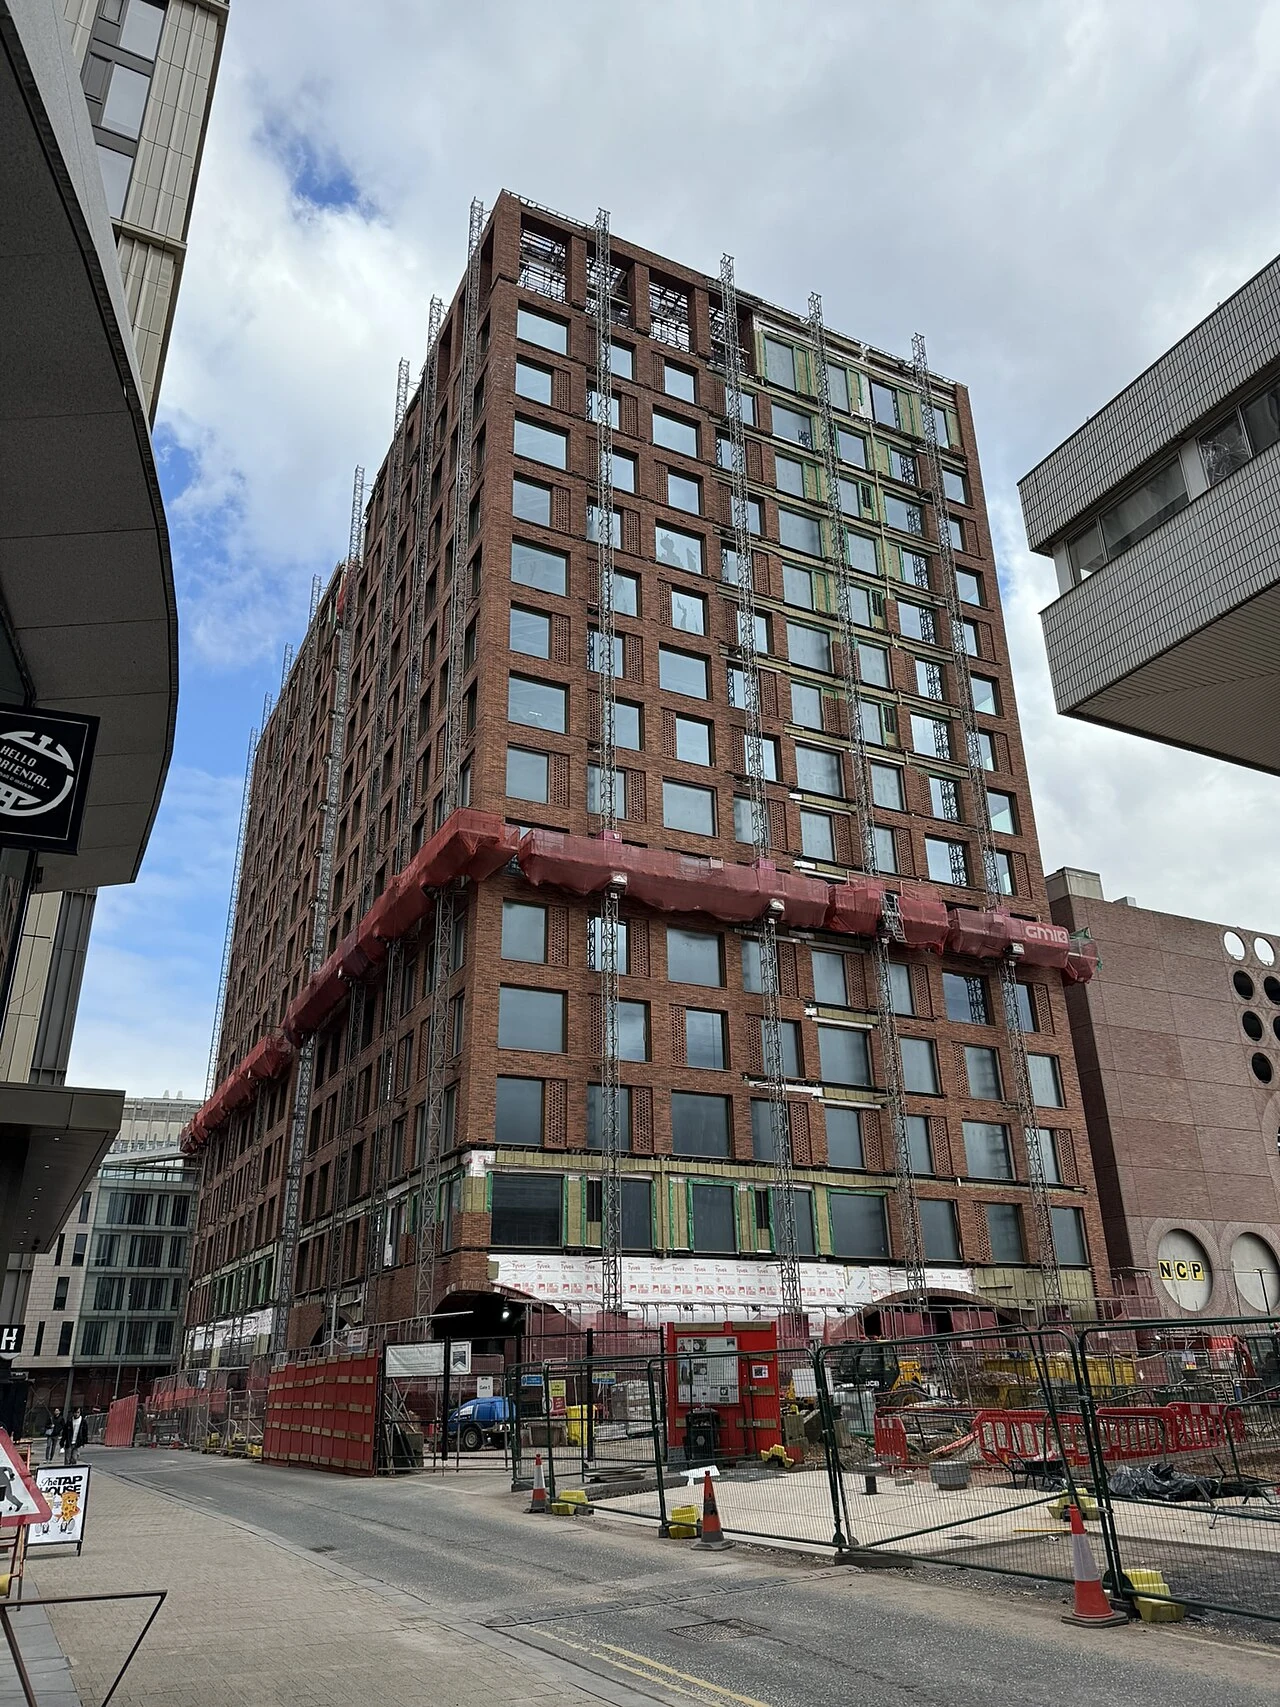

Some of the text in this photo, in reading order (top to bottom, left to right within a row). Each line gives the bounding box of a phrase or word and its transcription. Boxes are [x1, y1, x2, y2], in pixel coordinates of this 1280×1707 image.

[0, 745, 37, 767] HELLO
[0, 757, 50, 789] RIENTAL.
[1159, 1261, 1202, 1279] NCP
[56, 1475, 83, 1486] TAP
